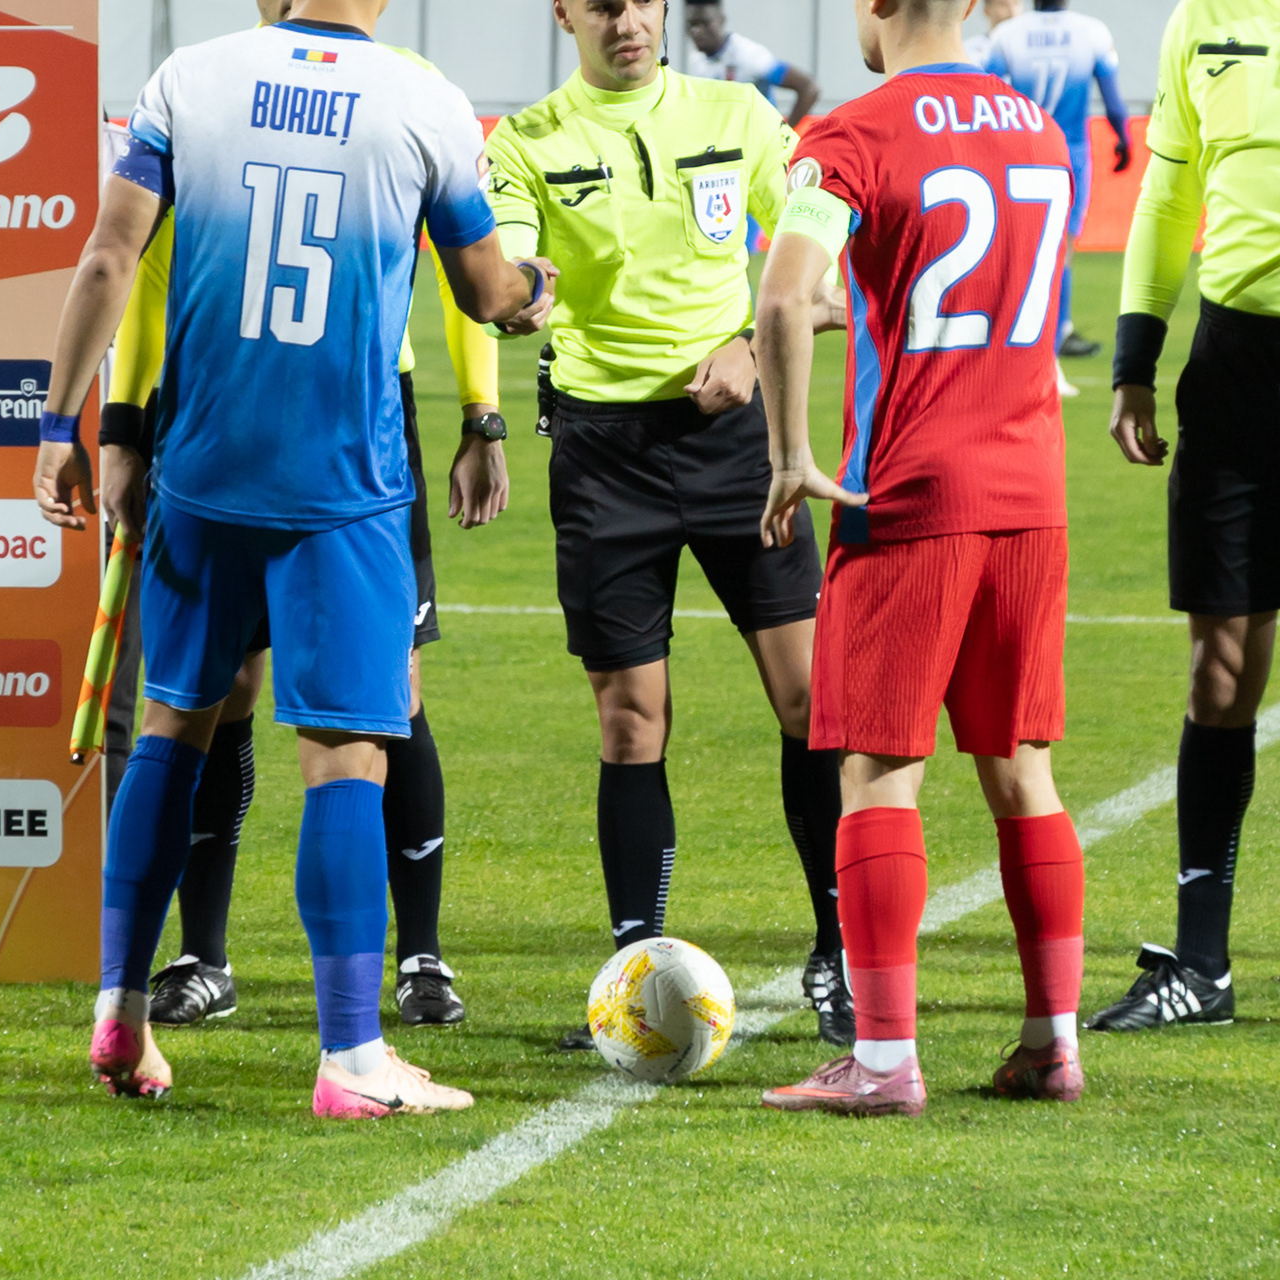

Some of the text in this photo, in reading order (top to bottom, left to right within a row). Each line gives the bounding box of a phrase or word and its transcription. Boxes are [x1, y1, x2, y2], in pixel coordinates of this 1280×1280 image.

[250, 80, 361, 146] BURDEȚ
[913, 95, 1045, 135] OLARU
[238, 161, 346, 347] 15
[903, 164, 1073, 354] 27
